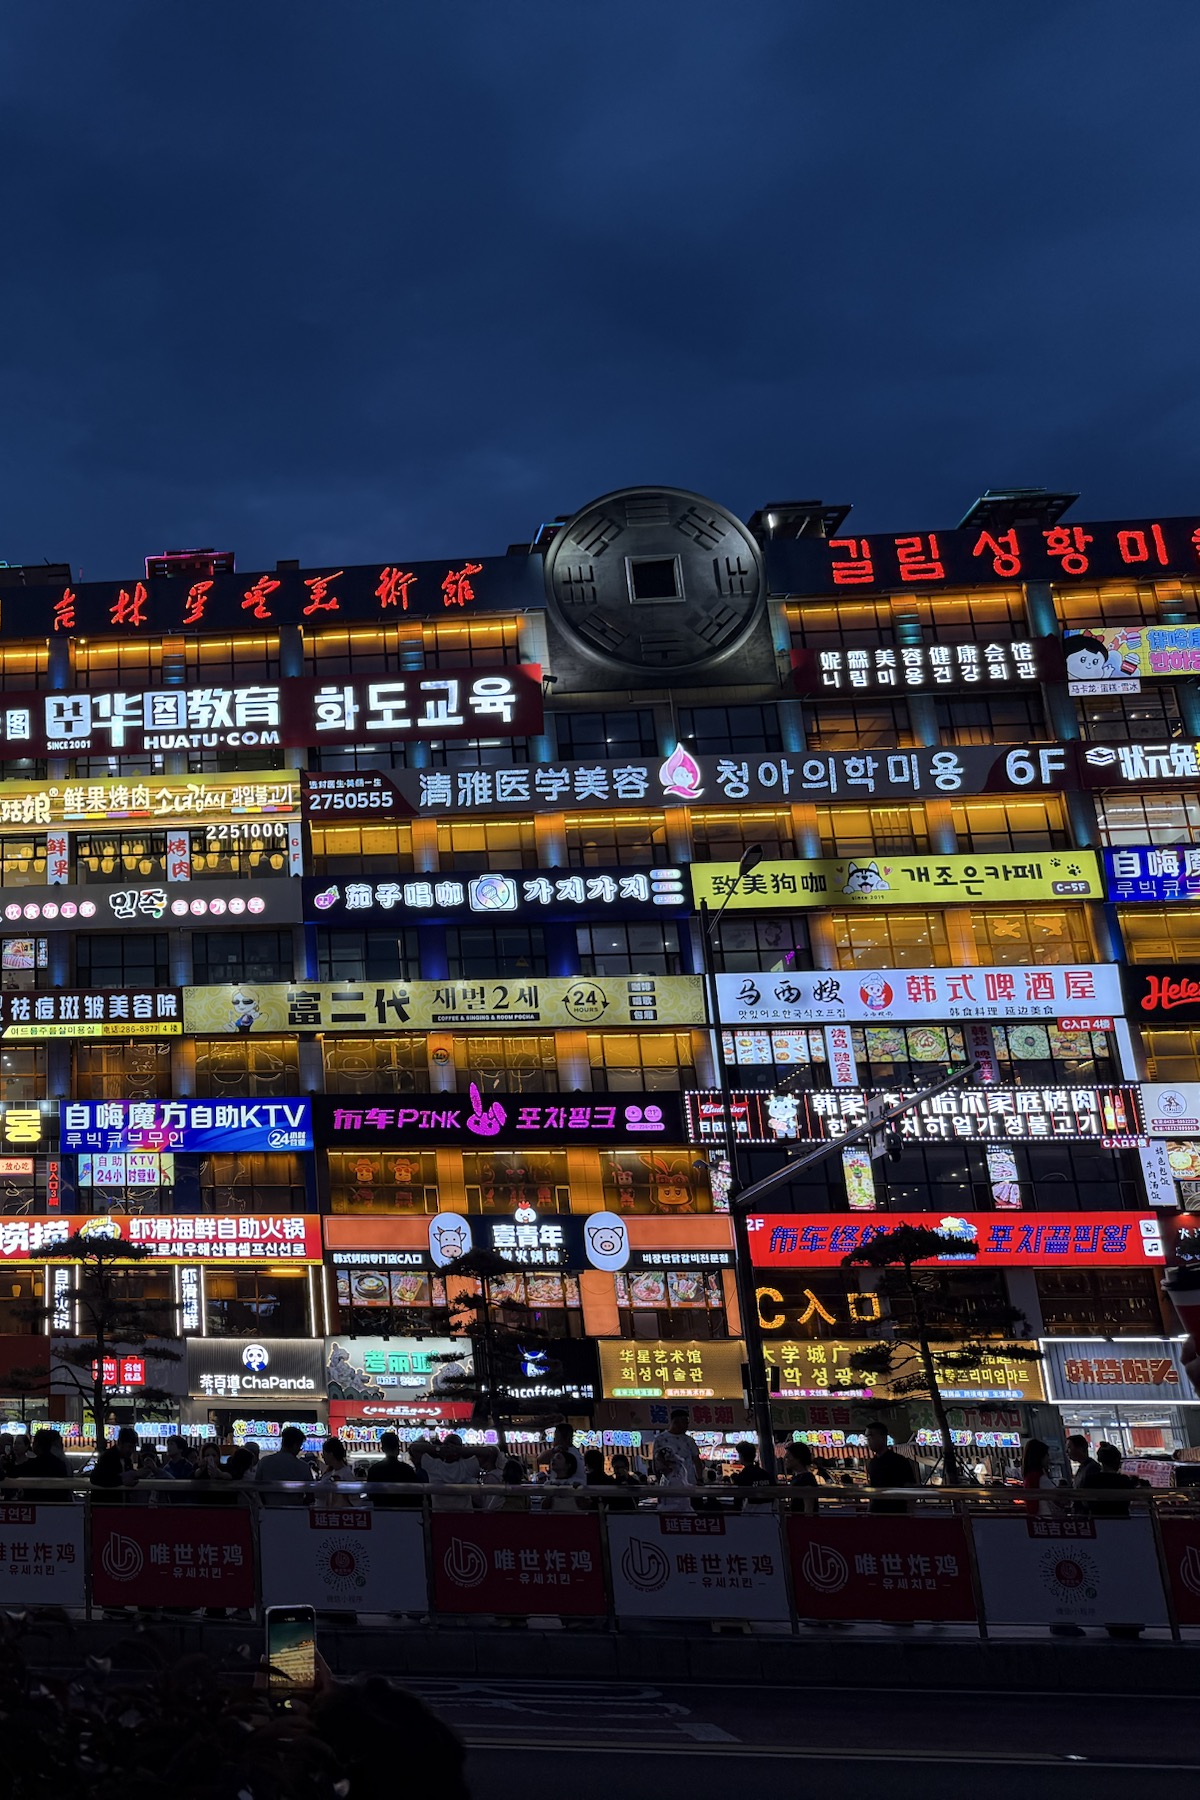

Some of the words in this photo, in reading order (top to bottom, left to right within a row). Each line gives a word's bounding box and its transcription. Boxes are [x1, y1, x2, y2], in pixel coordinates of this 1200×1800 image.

[314, 677, 517, 732] 화도교육
[47, 741, 68, 750] SINCE
[69, 740, 91, 749] 2001
[717, 751, 964, 799] 청아의학미용
[1005, 748, 1066, 786] 6F
[62, 784, 150, 813] 鲜果烤肉
[230, 783, 293, 807] 과일불고기
[419, 765, 649, 808] 清雅医学美容
[309, 791, 393, 811] 2750555
[47, 838, 69, 878] 鲜果
[166, 838, 190, 879] 烤肉
[523, 873, 650, 906] 가지가지
[710, 871, 828, 898] 致美狗咖
[901, 863, 1043, 896] 개조은카페
[431, 984, 540, 1011] 재벌2세
[572, 991, 597, 1007] 24
[905, 970, 1097, 1004] 韩式啤酒屋
[286, 988, 411, 1026] 富二代
[949, 1006, 999, 1018] 韩食料理
[1004, 1005, 1054, 1016] 延边美食
[65, 1102, 306, 1132] 自嗨魔方自助KTV
[397, 1109, 462, 1130] PINK
[515, 1106, 617, 1130] 포차핑크
[66, 1131, 185, 1150] 루빅큐브무인
[270, 1132, 290, 1146] 24
[98, 1155, 123, 1167] 自助
[129, 1155, 155, 1167] KTV
[128, 1216, 306, 1241] 虾滑海鲜自助火锅
[746, 1219, 765, 1231] 2F
[363, 1349, 433, 1375] 考丽亚
[619, 1349, 702, 1365] 华星艺术馆
[199, 1375, 241, 1390] 茶百道
[241, 1375, 315, 1391] ChaPanda
[620, 1366, 704, 1383] 화성예술관
[149, 1542, 244, 1566] 唯世炸鸡
[493, 1548, 593, 1573] 唯世炸鸡
[675, 1553, 774, 1577] 唯世炸鸡
[854, 1552, 960, 1578] 唯世炸鸡
[8, 1564, 55, 1576] 유세치킨
[172, 1566, 223, 1579] 유세치킨
[518, 1572, 571, 1586] 유세치킨
[701, 1576, 753, 1589] 유세치킨
[881, 1577, 937, 1592] 유세치킨
